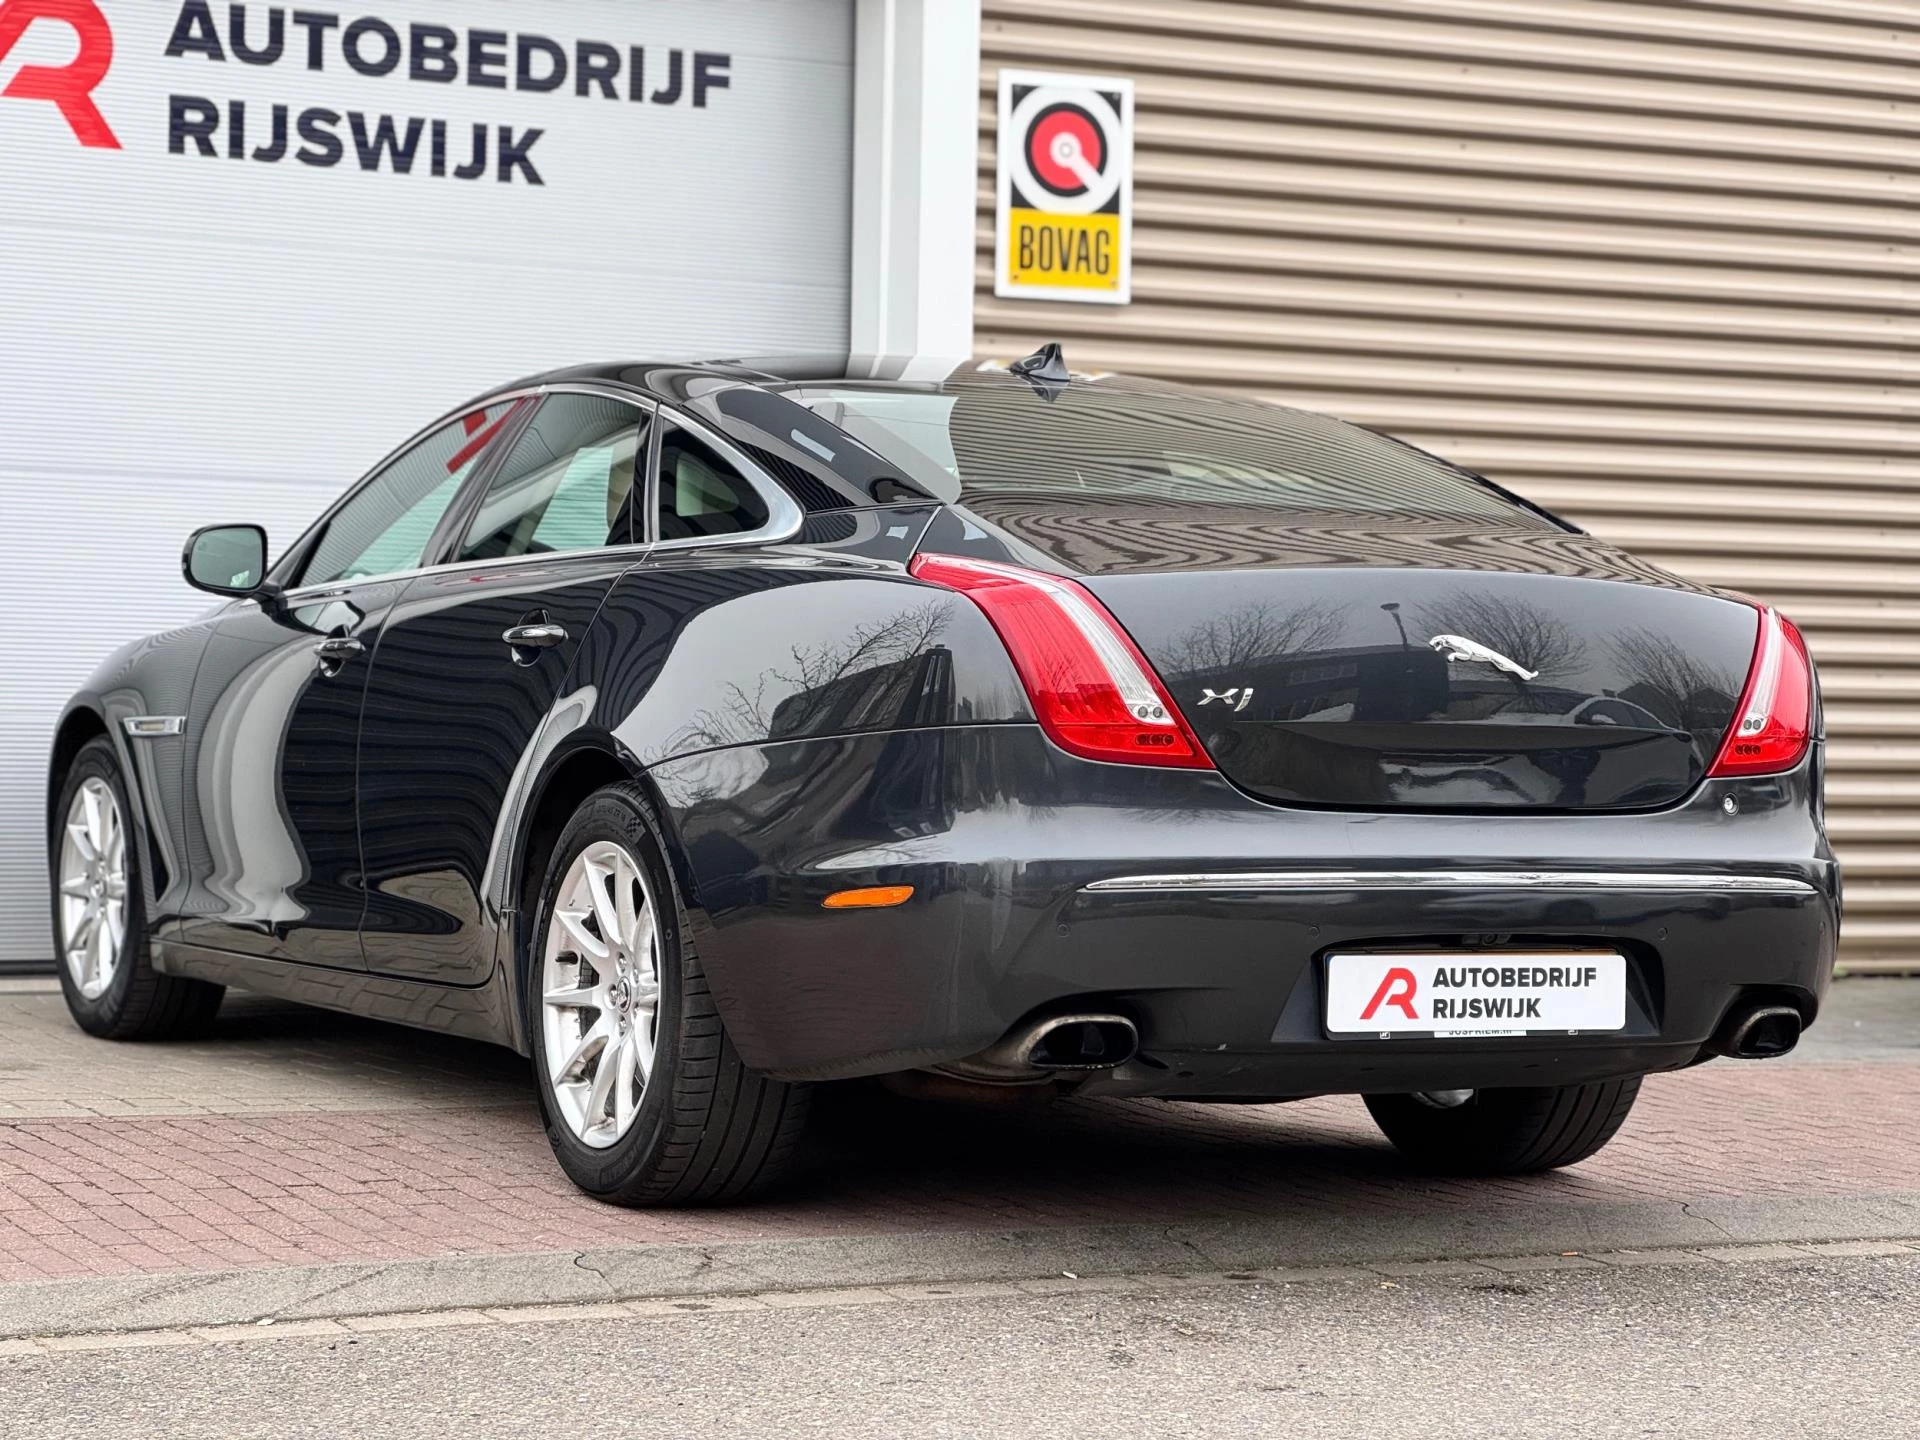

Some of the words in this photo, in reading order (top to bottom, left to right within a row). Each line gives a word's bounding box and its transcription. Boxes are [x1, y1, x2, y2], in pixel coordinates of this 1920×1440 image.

[164, 0, 731, 108] AUTOBEDRIJF
[168, 95, 545, 186] RIJSWIJK
[1019, 225, 1110, 275] BOVAG
[1197, 688, 1254, 712] XJ
[1432, 967, 1597, 988] AUTOBEDRIJF
[1432, 997, 1541, 1019] RIJSWIJK
